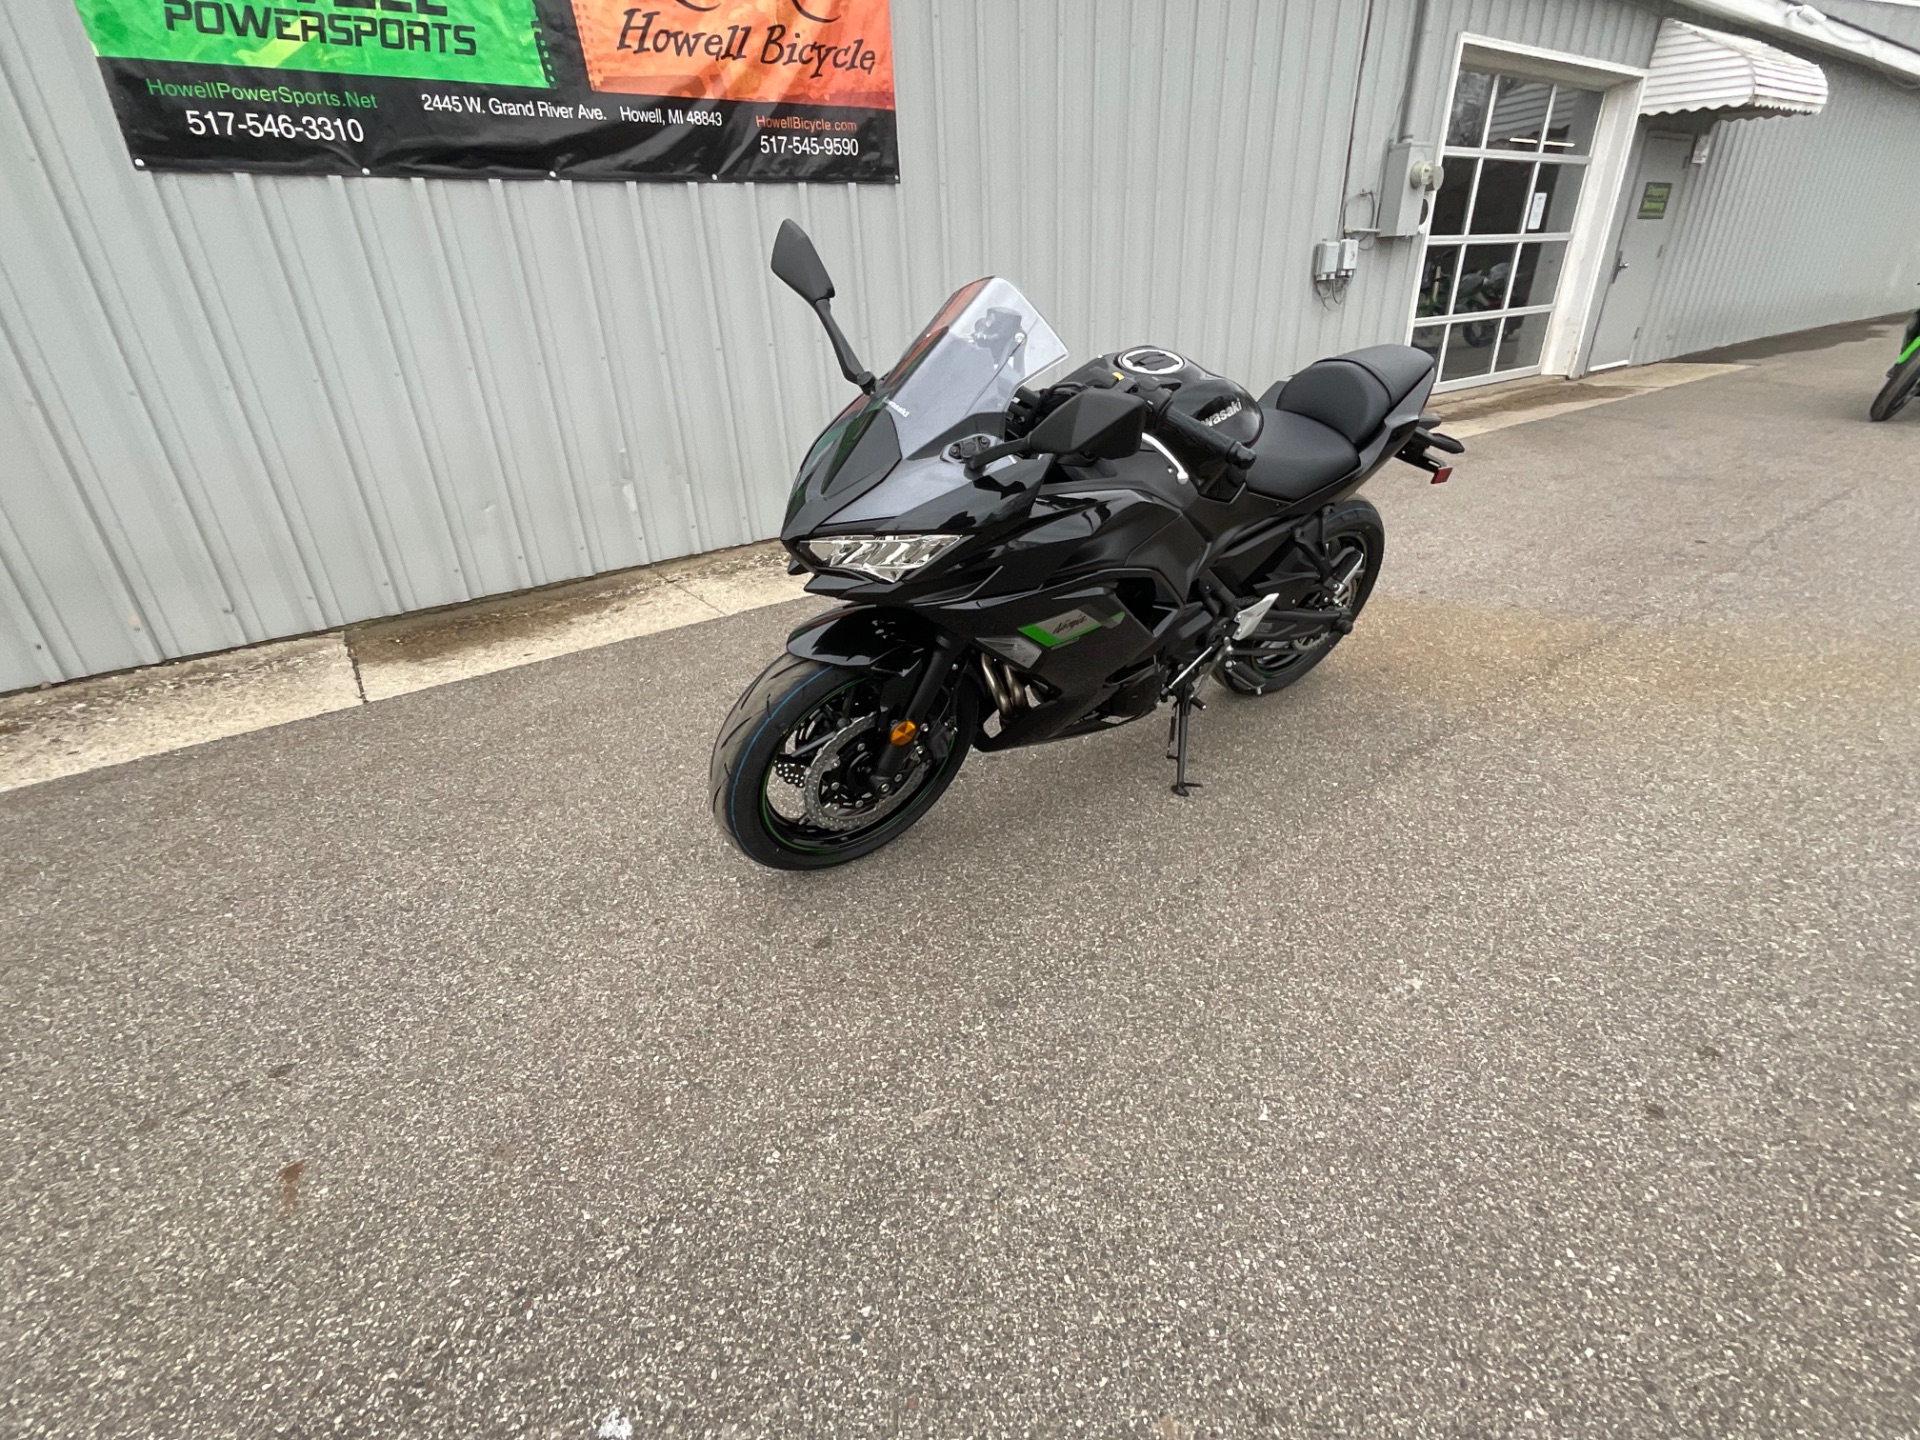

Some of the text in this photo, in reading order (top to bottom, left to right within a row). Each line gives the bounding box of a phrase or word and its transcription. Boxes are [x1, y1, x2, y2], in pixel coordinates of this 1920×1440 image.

[163, 0, 477, 56] POWERSPORTS
[616, 8, 876, 79] Howell Bicycle
[145, 78, 378, 109] HowellPowerSports.Net
[421, 94, 607, 121] 2445 W. Grand River Ave.
[185, 109, 364, 143] 517-546-3310
[619, 106, 723, 126] Howell, MI 48843
[755, 115, 858, 133] HowellBicycle.com
[760, 135, 859, 156] 517-545-9590
[1200, 397, 1242, 427] wasaki
